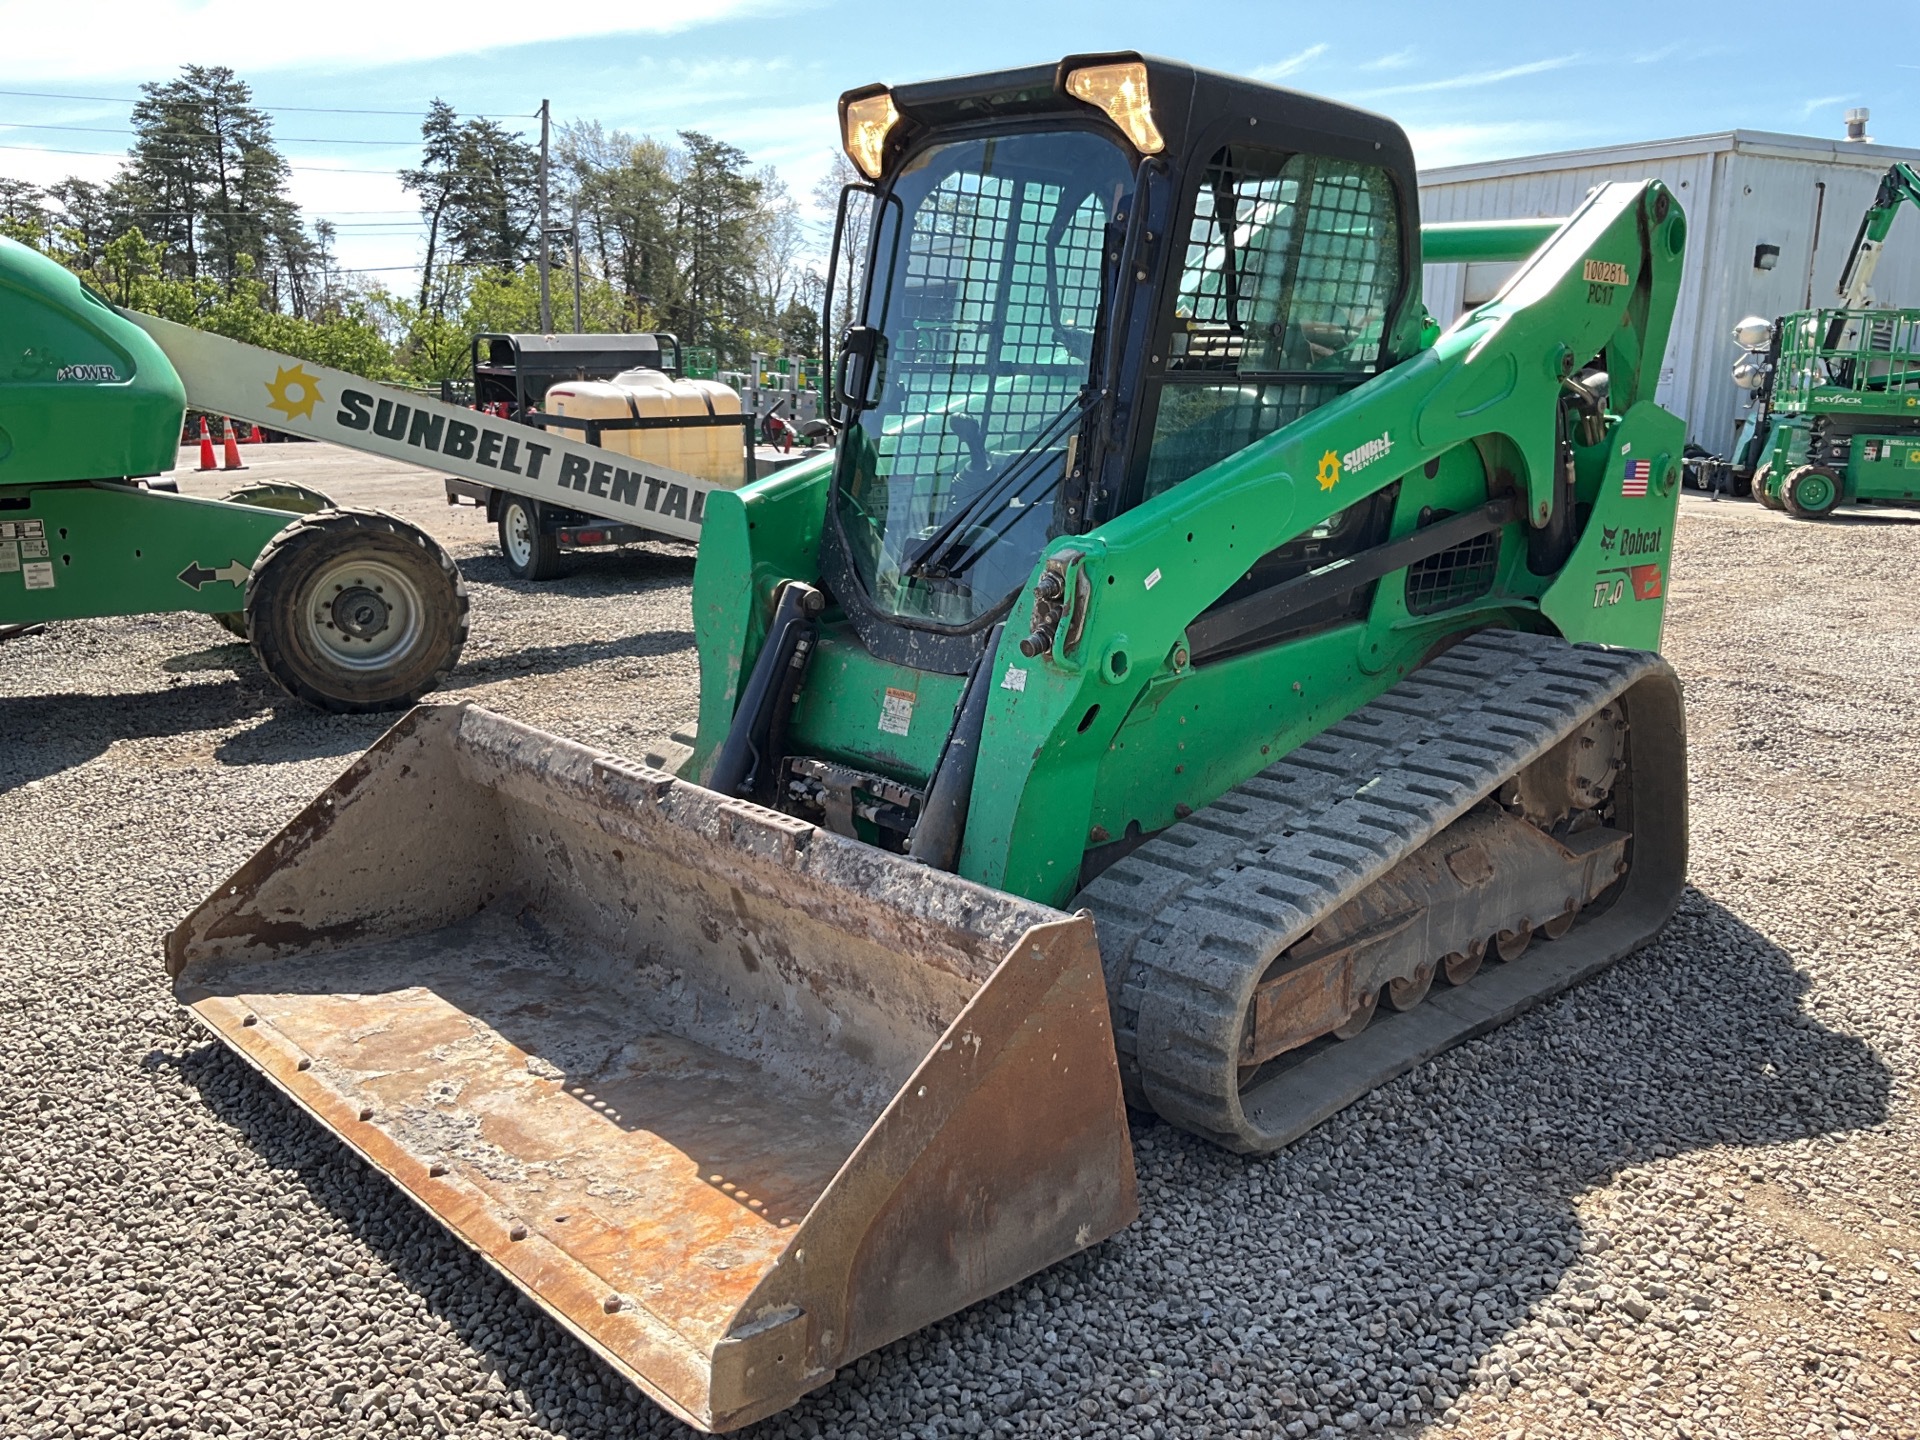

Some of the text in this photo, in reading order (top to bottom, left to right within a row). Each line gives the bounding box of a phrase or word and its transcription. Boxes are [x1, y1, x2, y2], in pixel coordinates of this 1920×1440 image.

[1587, 284, 1614, 305] PC17
[1814, 394, 1862, 404] SKYJACK
[336, 389, 706, 524] SUNBELT RENTAL
[1343, 431, 1394, 471] SUNBEL
[1352, 448, 1390, 474] RENTALS
[1620, 527, 1661, 556] Bobcat
